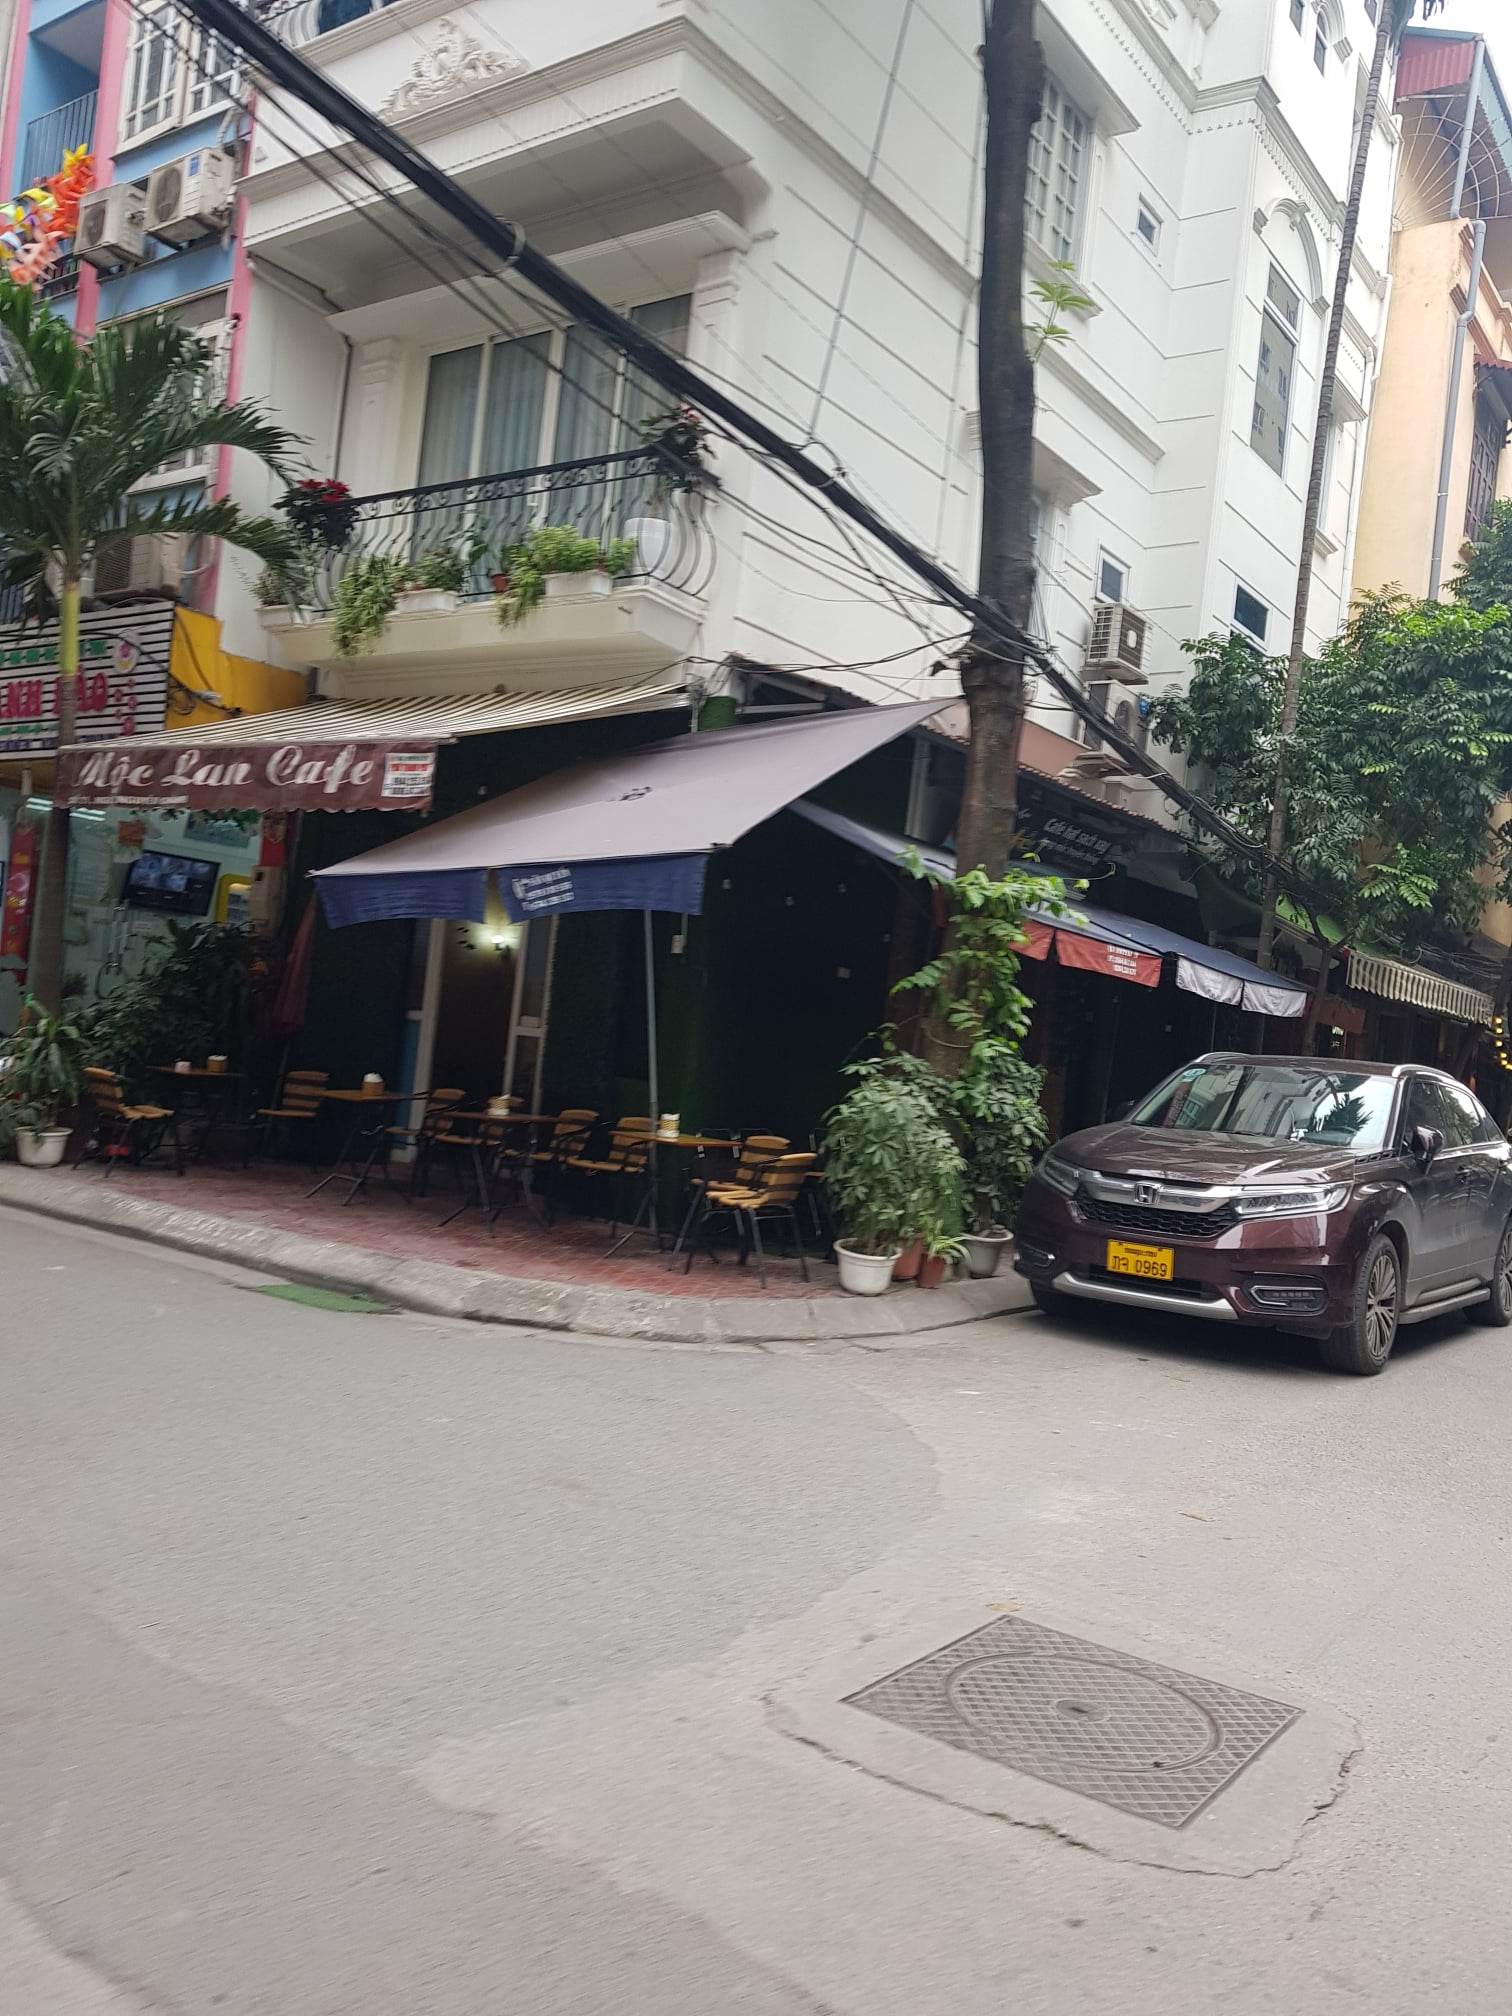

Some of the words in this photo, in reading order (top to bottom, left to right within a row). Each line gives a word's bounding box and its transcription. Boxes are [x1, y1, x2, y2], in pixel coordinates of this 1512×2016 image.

[160, 749, 252, 787] Lan
[265, 745, 374, 794] Cafe
[1135, 1259, 1168, 1277] 0969
